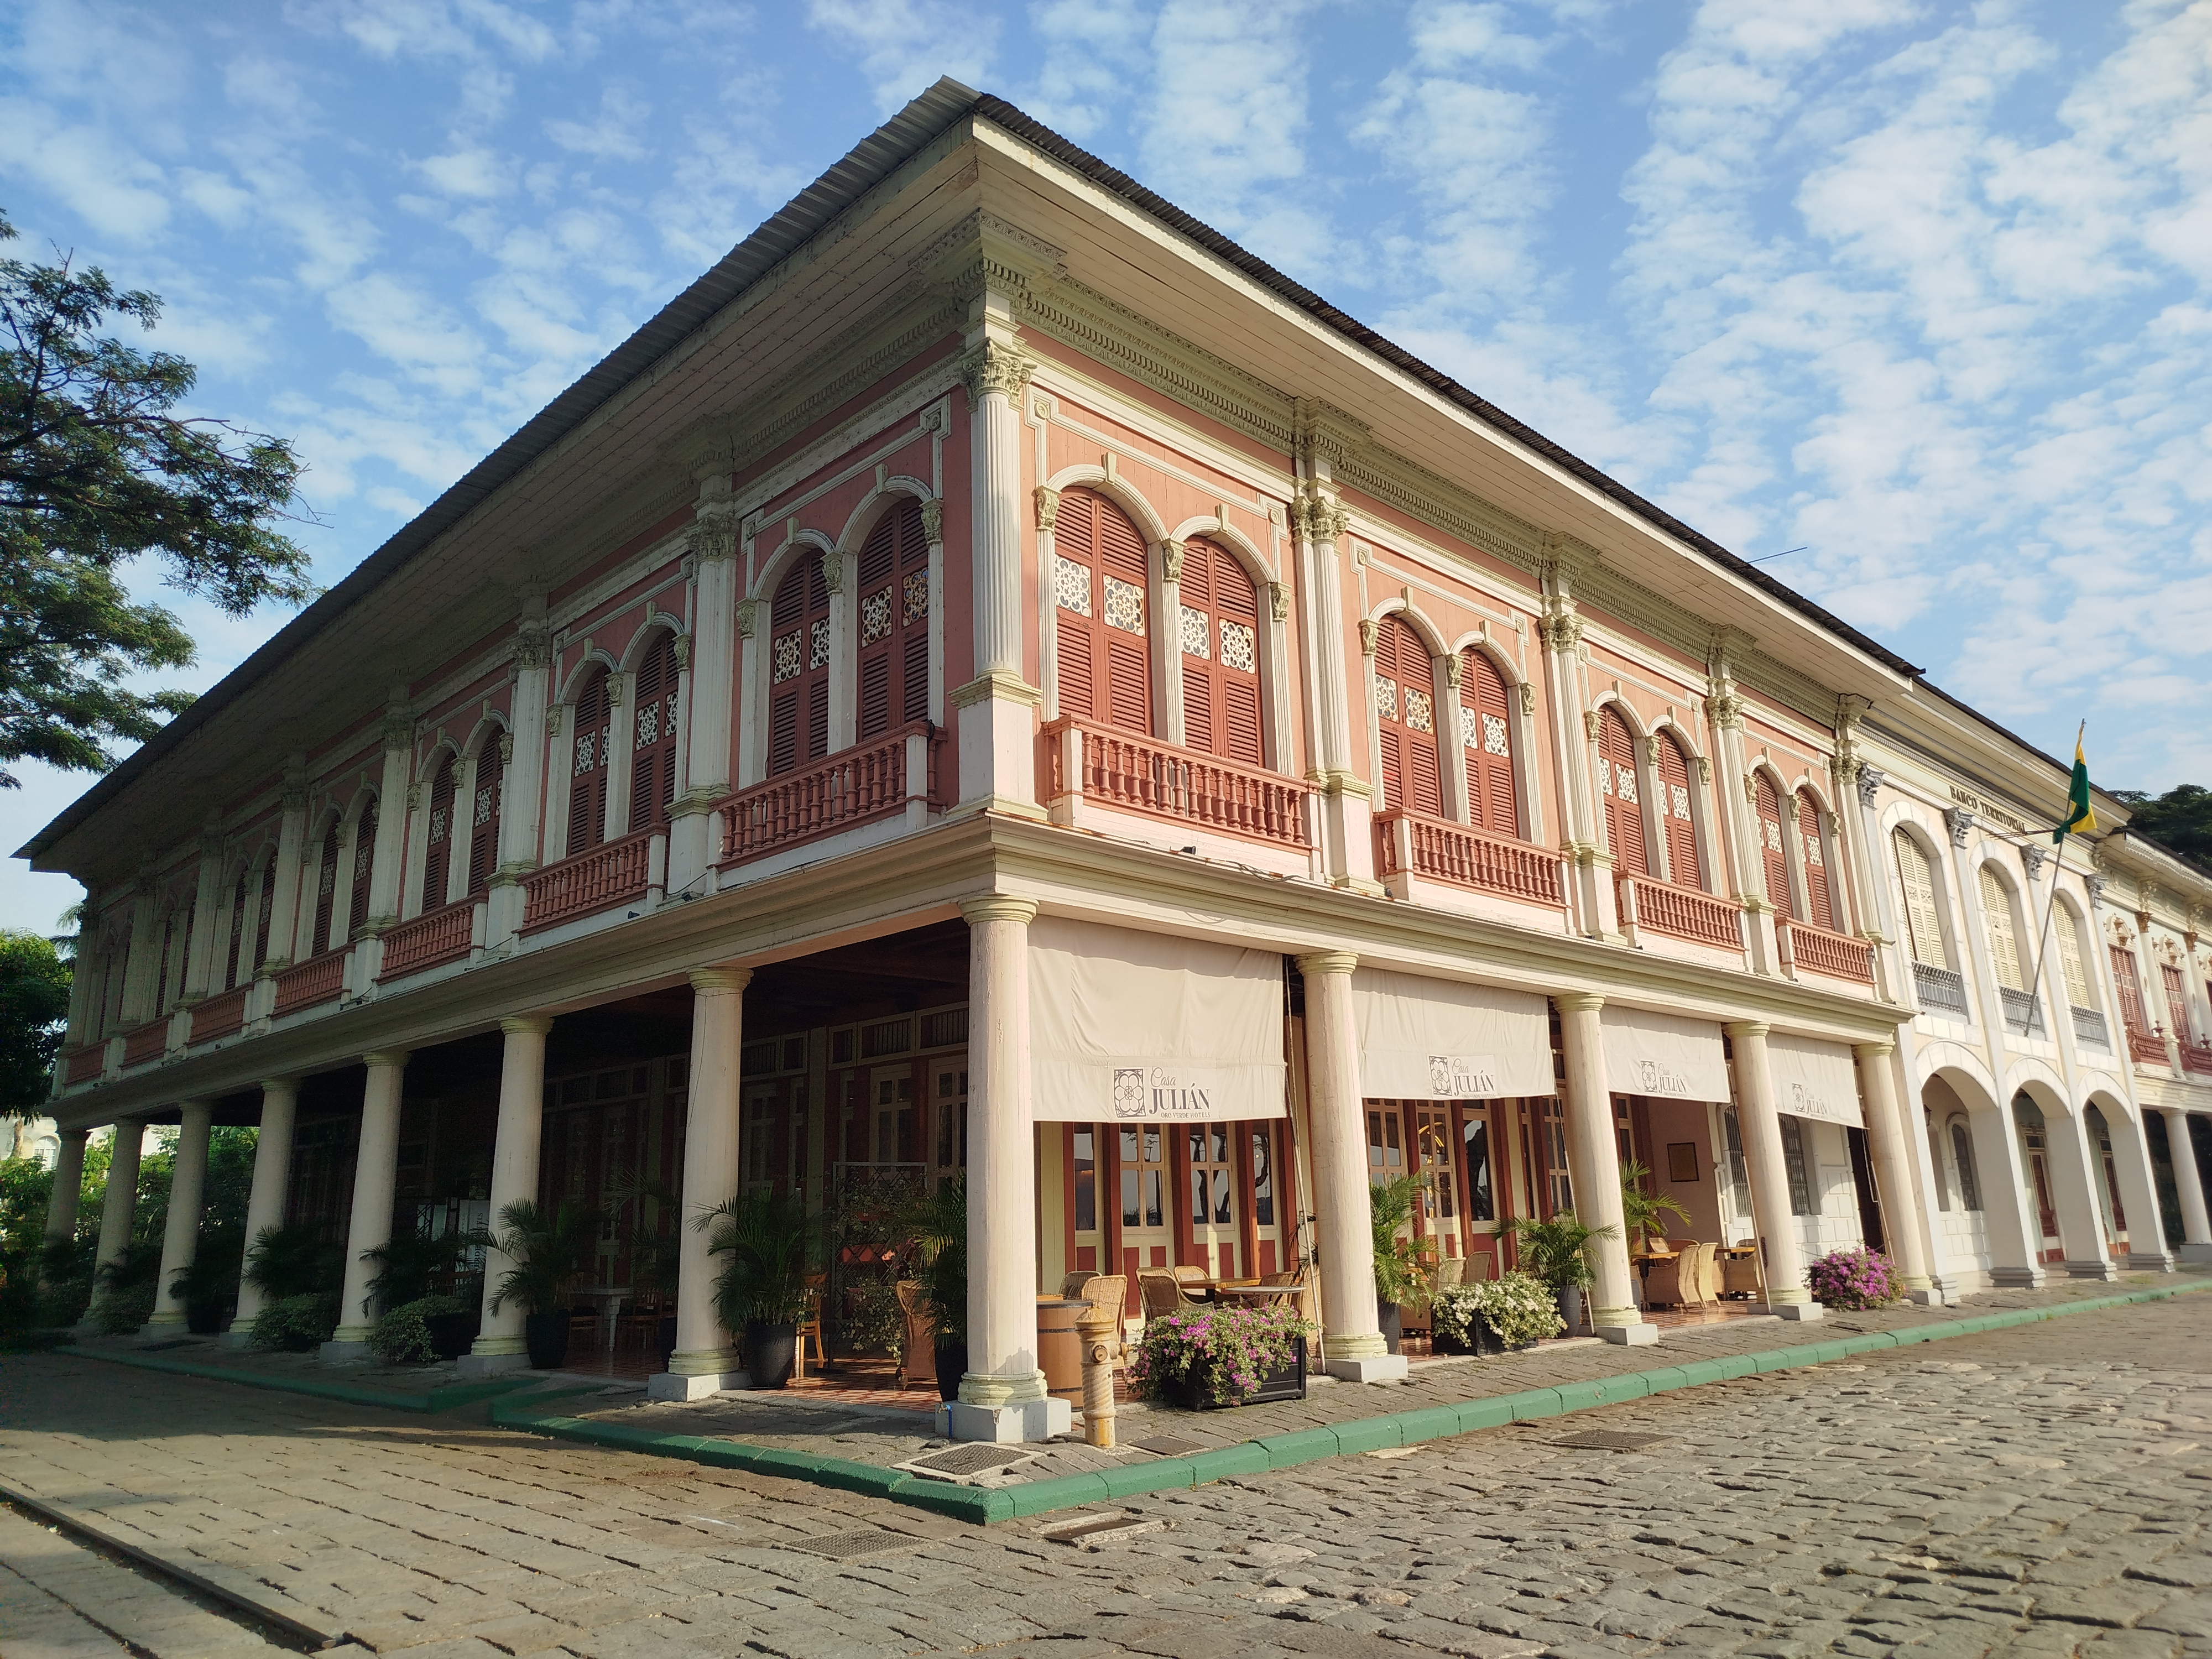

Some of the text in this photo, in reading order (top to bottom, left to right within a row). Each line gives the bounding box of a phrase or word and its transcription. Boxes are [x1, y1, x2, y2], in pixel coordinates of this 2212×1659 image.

[1949, 785, 2025, 832] BANCO TERRITORIAL
[1150, 1067, 1177, 1087] Casa
[1452, 1058, 1469, 1074] Casa
[1453, 1070, 1494, 1096] JULIÁN
[1659, 1074, 1686, 1093] JULIÁN
[1149, 1082, 1211, 1114] JULIÁN
